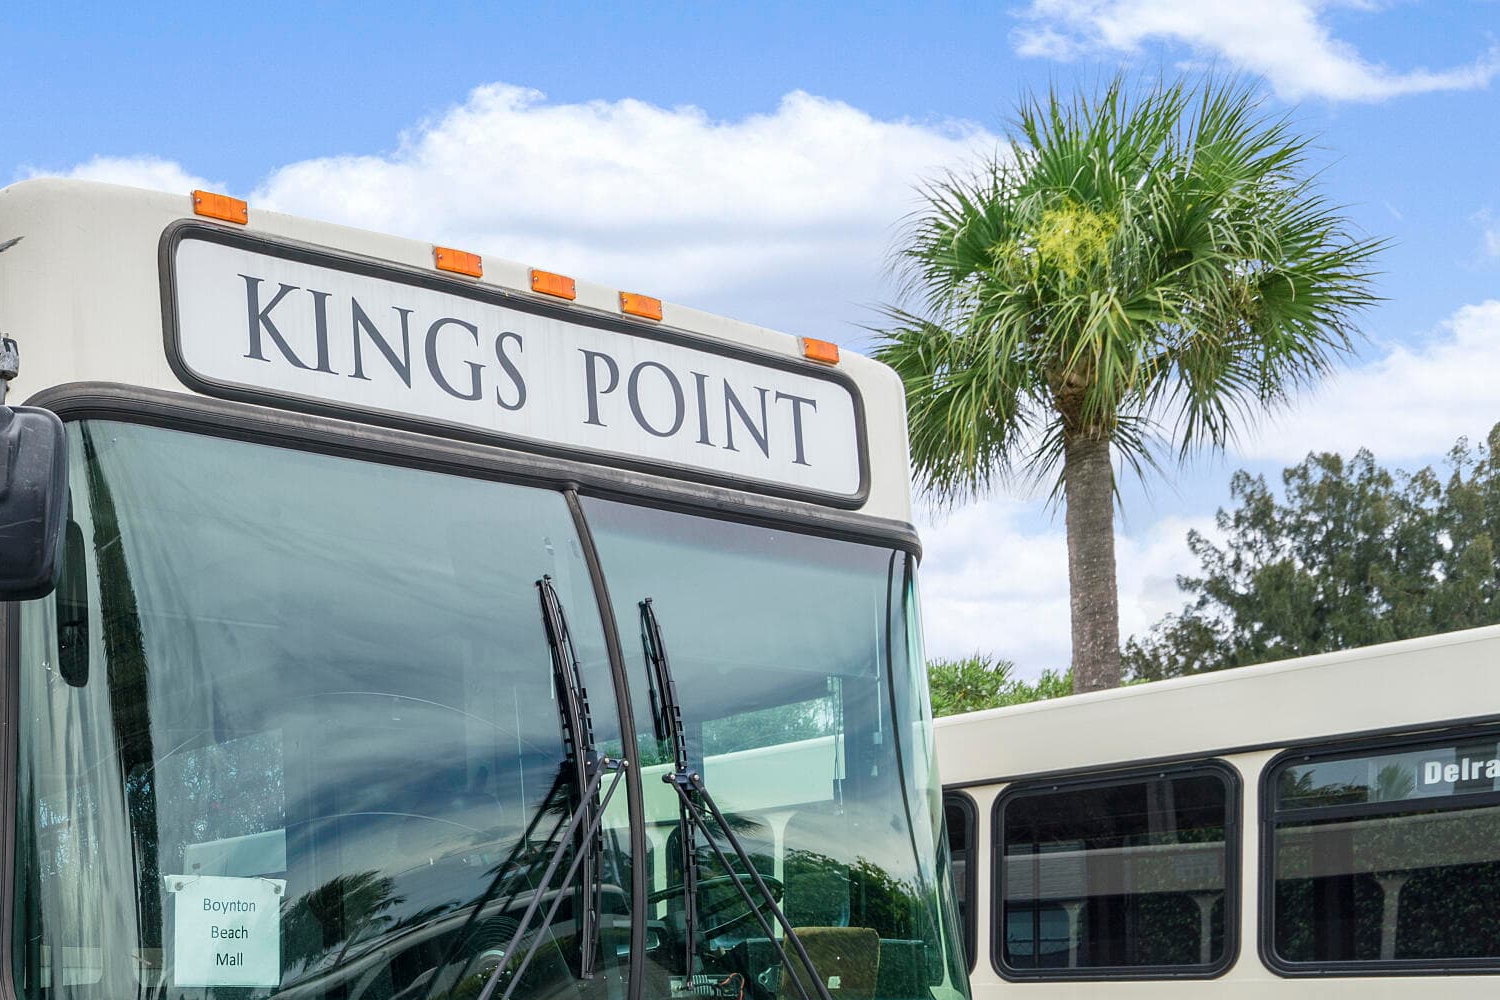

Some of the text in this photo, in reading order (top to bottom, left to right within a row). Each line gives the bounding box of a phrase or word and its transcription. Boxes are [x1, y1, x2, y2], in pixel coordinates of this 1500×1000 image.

[236, 273, 819, 468] KINGS POINT
[1424, 757, 1500, 785] Delra
[203, 898, 256, 915] Boynton
[211, 925, 248, 939] Beach
[215, 952, 243, 966] Mall
